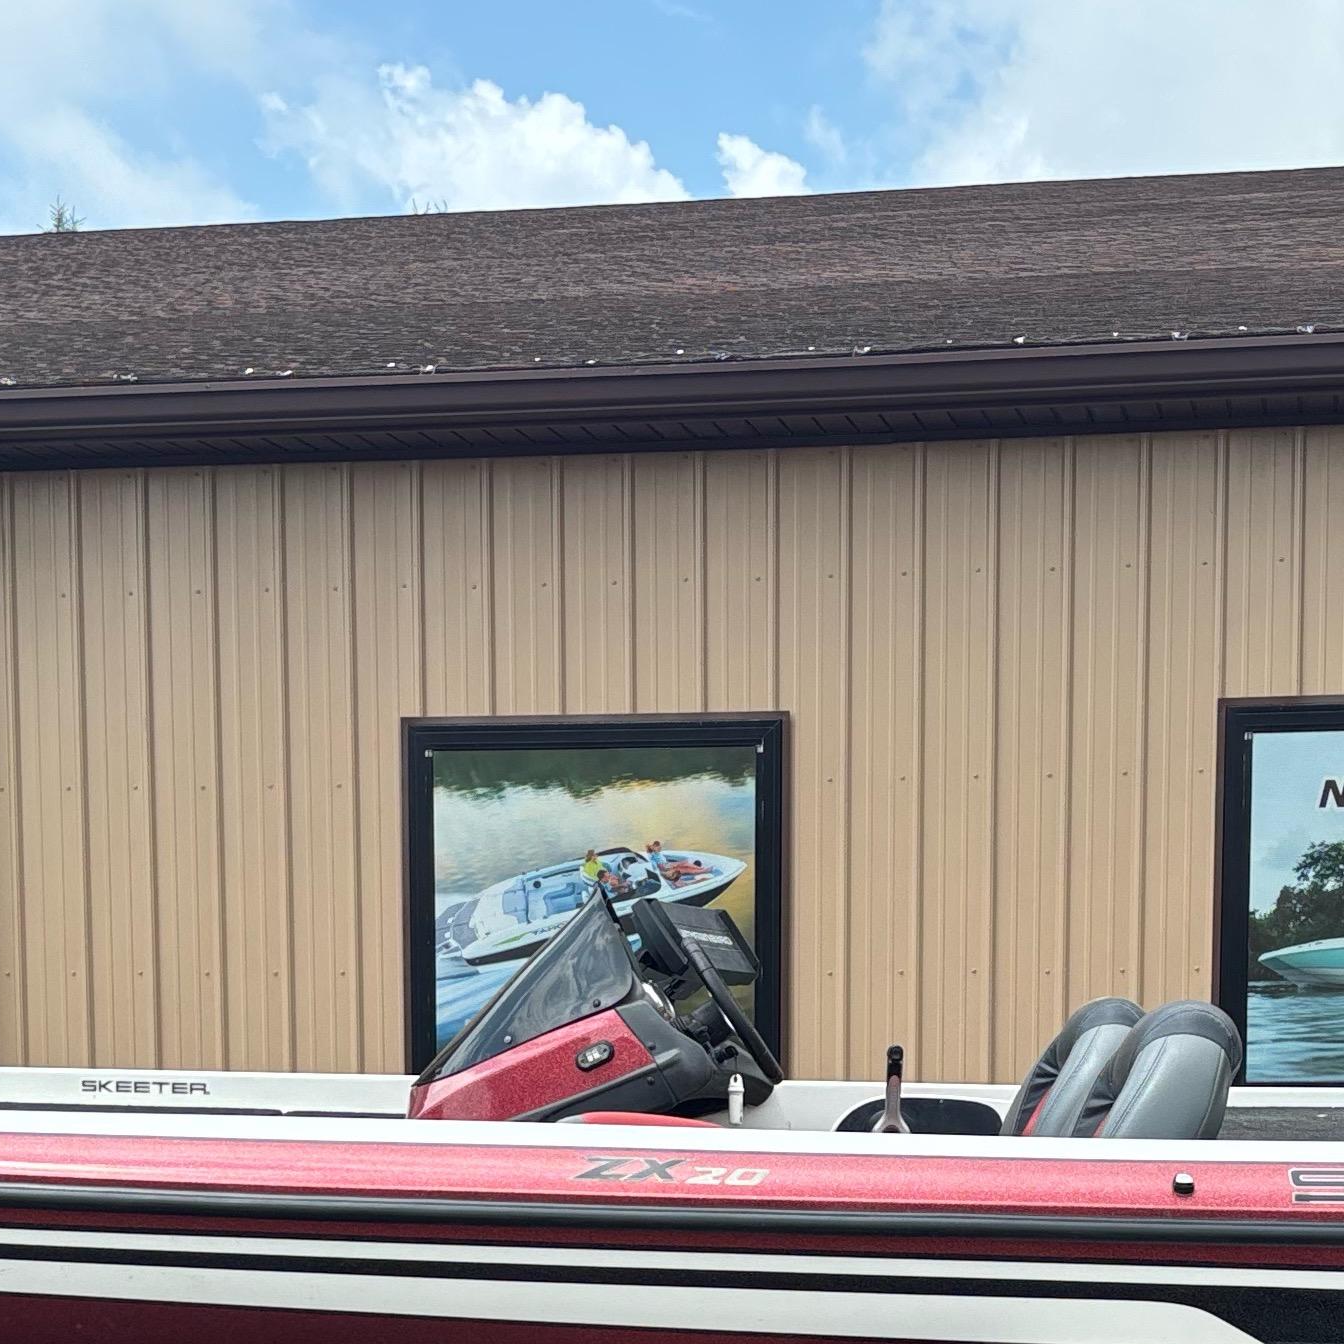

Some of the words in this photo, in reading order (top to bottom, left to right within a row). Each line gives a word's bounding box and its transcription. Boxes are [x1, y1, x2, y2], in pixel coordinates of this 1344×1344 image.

[81, 1080, 208, 1095] SKEETER
[572, 1157, 686, 1183] ZX
[686, 1167, 770, 1186] 20
